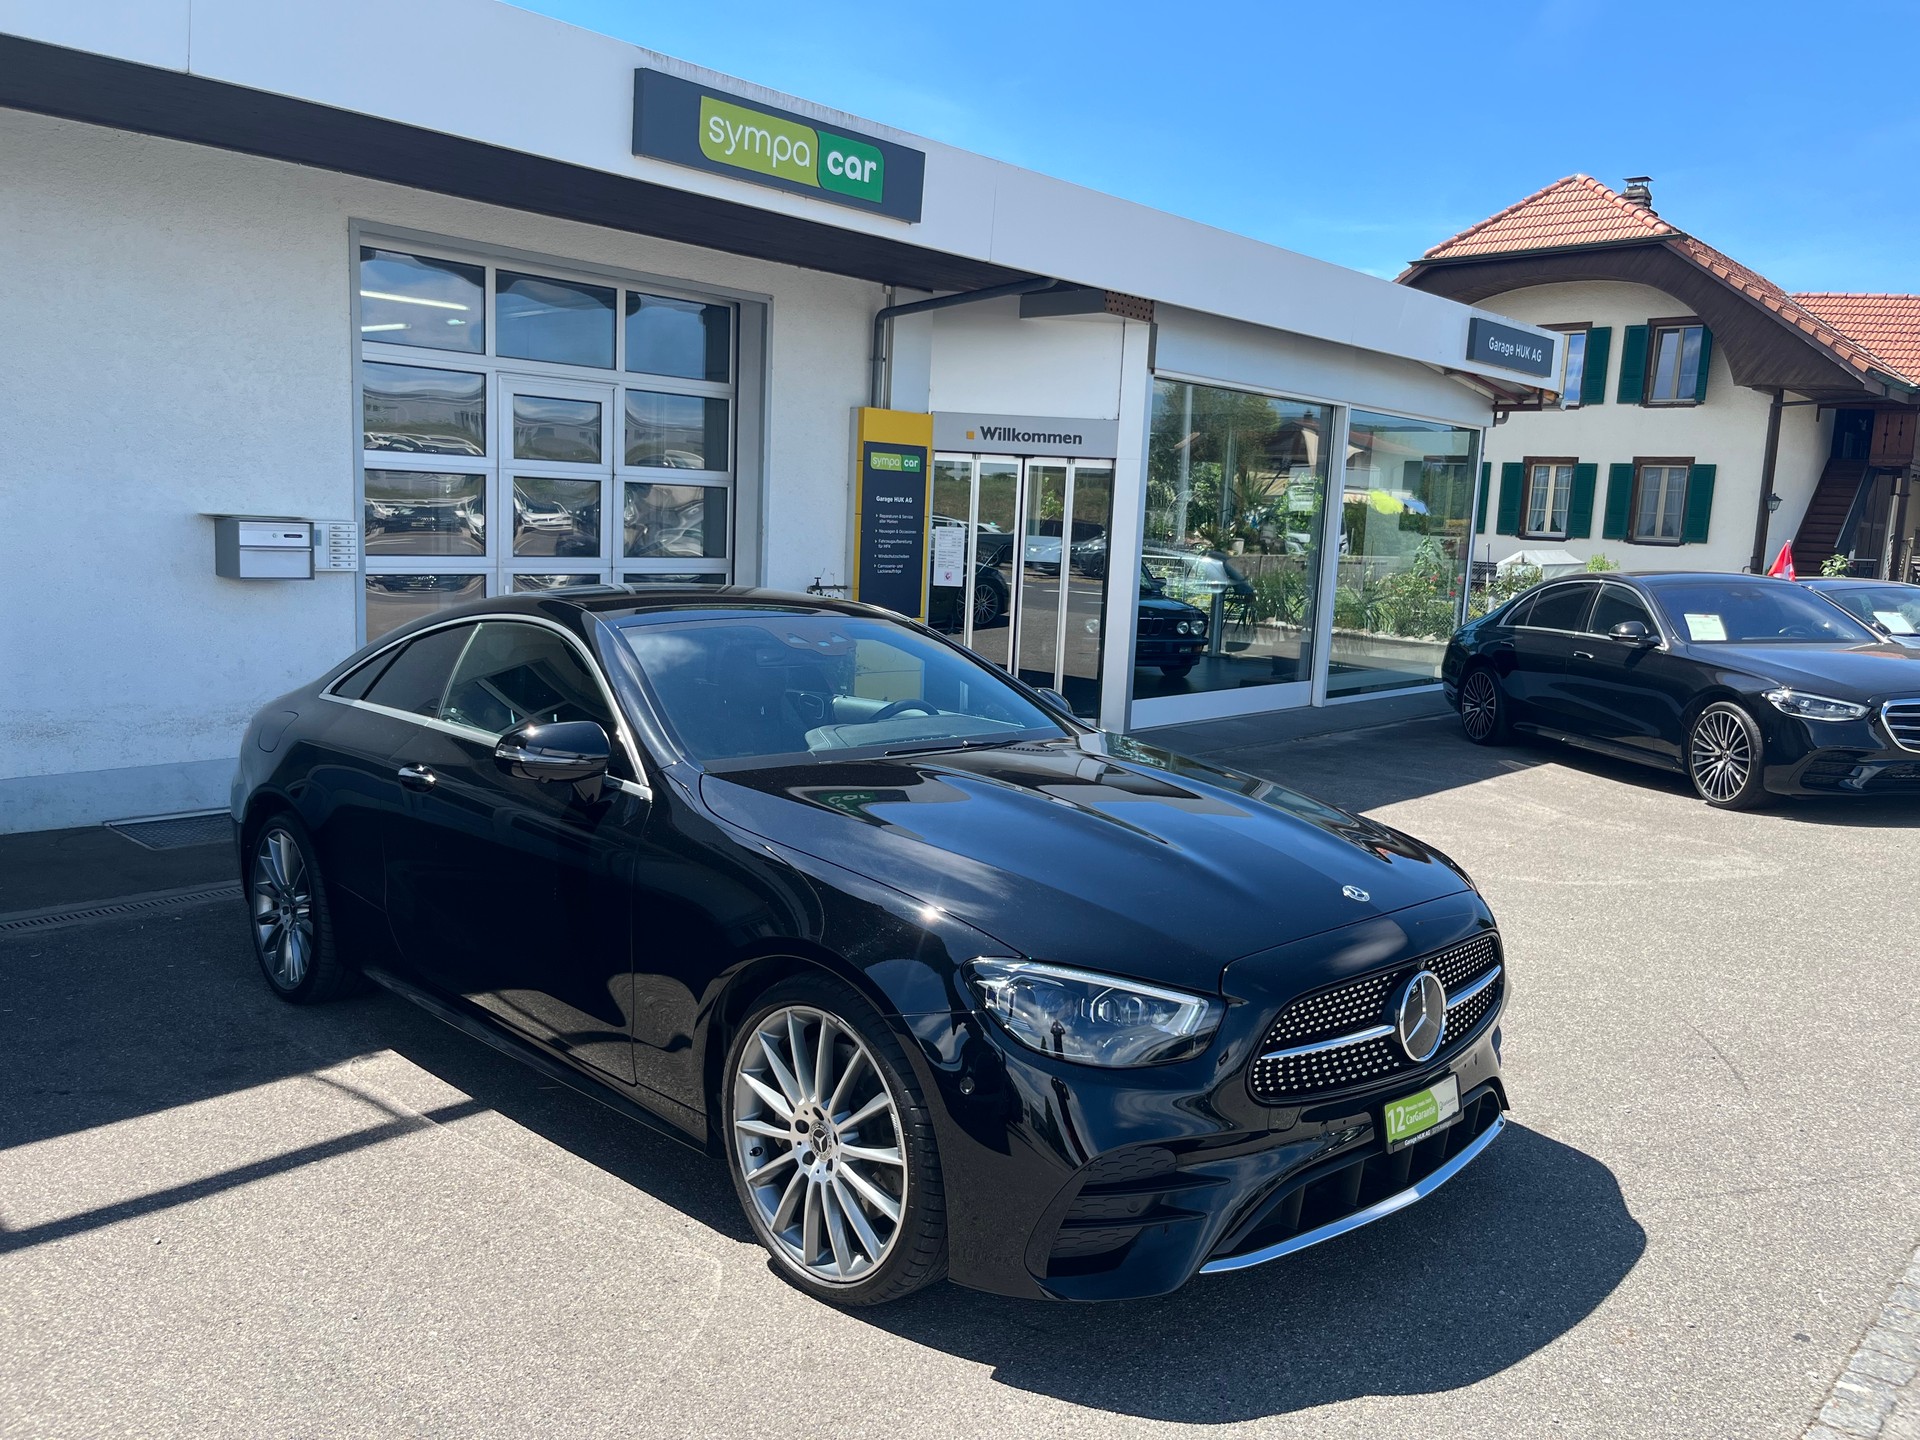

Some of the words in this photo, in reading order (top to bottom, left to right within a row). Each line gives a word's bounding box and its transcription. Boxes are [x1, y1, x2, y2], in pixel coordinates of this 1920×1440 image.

[708, 115, 810, 168] sympa
[827, 151, 877, 183] car
[1488, 336, 1514, 357] Garage
[1515, 343, 1531, 360] HUK
[1531, 348, 1542, 363] AG
[980, 426, 1082, 445] Willkommen
[872, 456, 900, 469] sympa
[903, 459, 919, 468] car
[876, 495, 893, 503] Garage
[1388, 1106, 1406, 1134] 12
[1404, 1137, 1417, 1146] Garage
